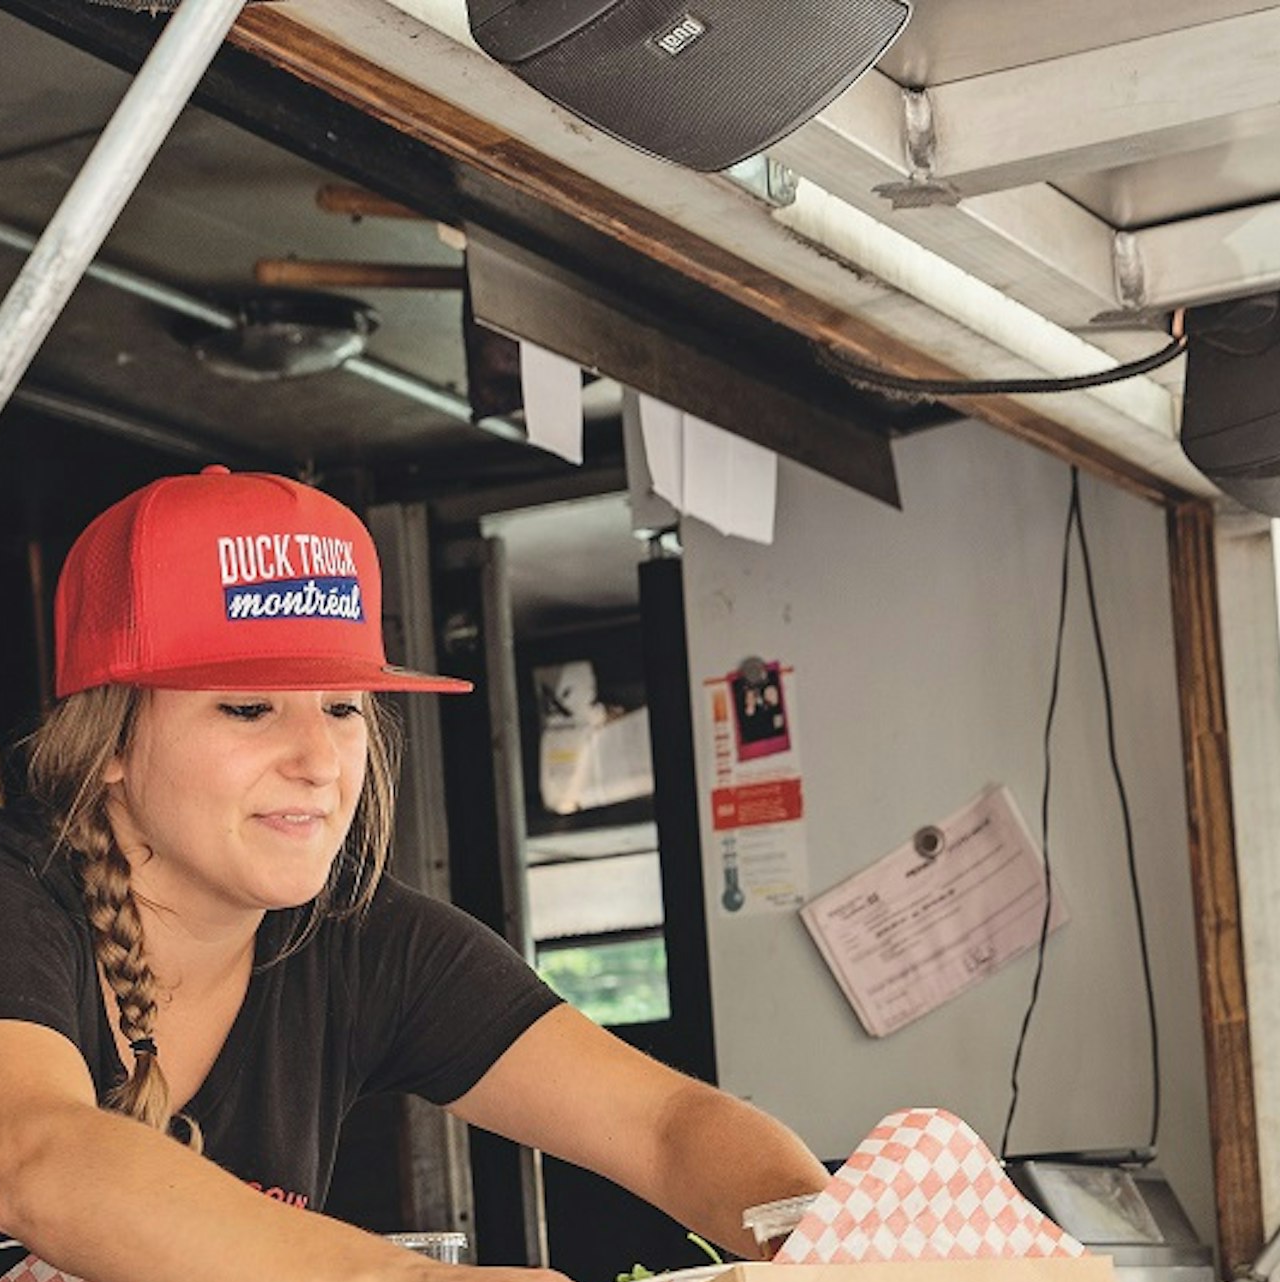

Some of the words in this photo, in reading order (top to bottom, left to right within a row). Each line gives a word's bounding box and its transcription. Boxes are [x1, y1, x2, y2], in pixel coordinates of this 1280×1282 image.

[218, 534, 295, 585] DUCK
[295, 534, 357, 576] TRUCK
[228, 580, 361, 620] montréal
